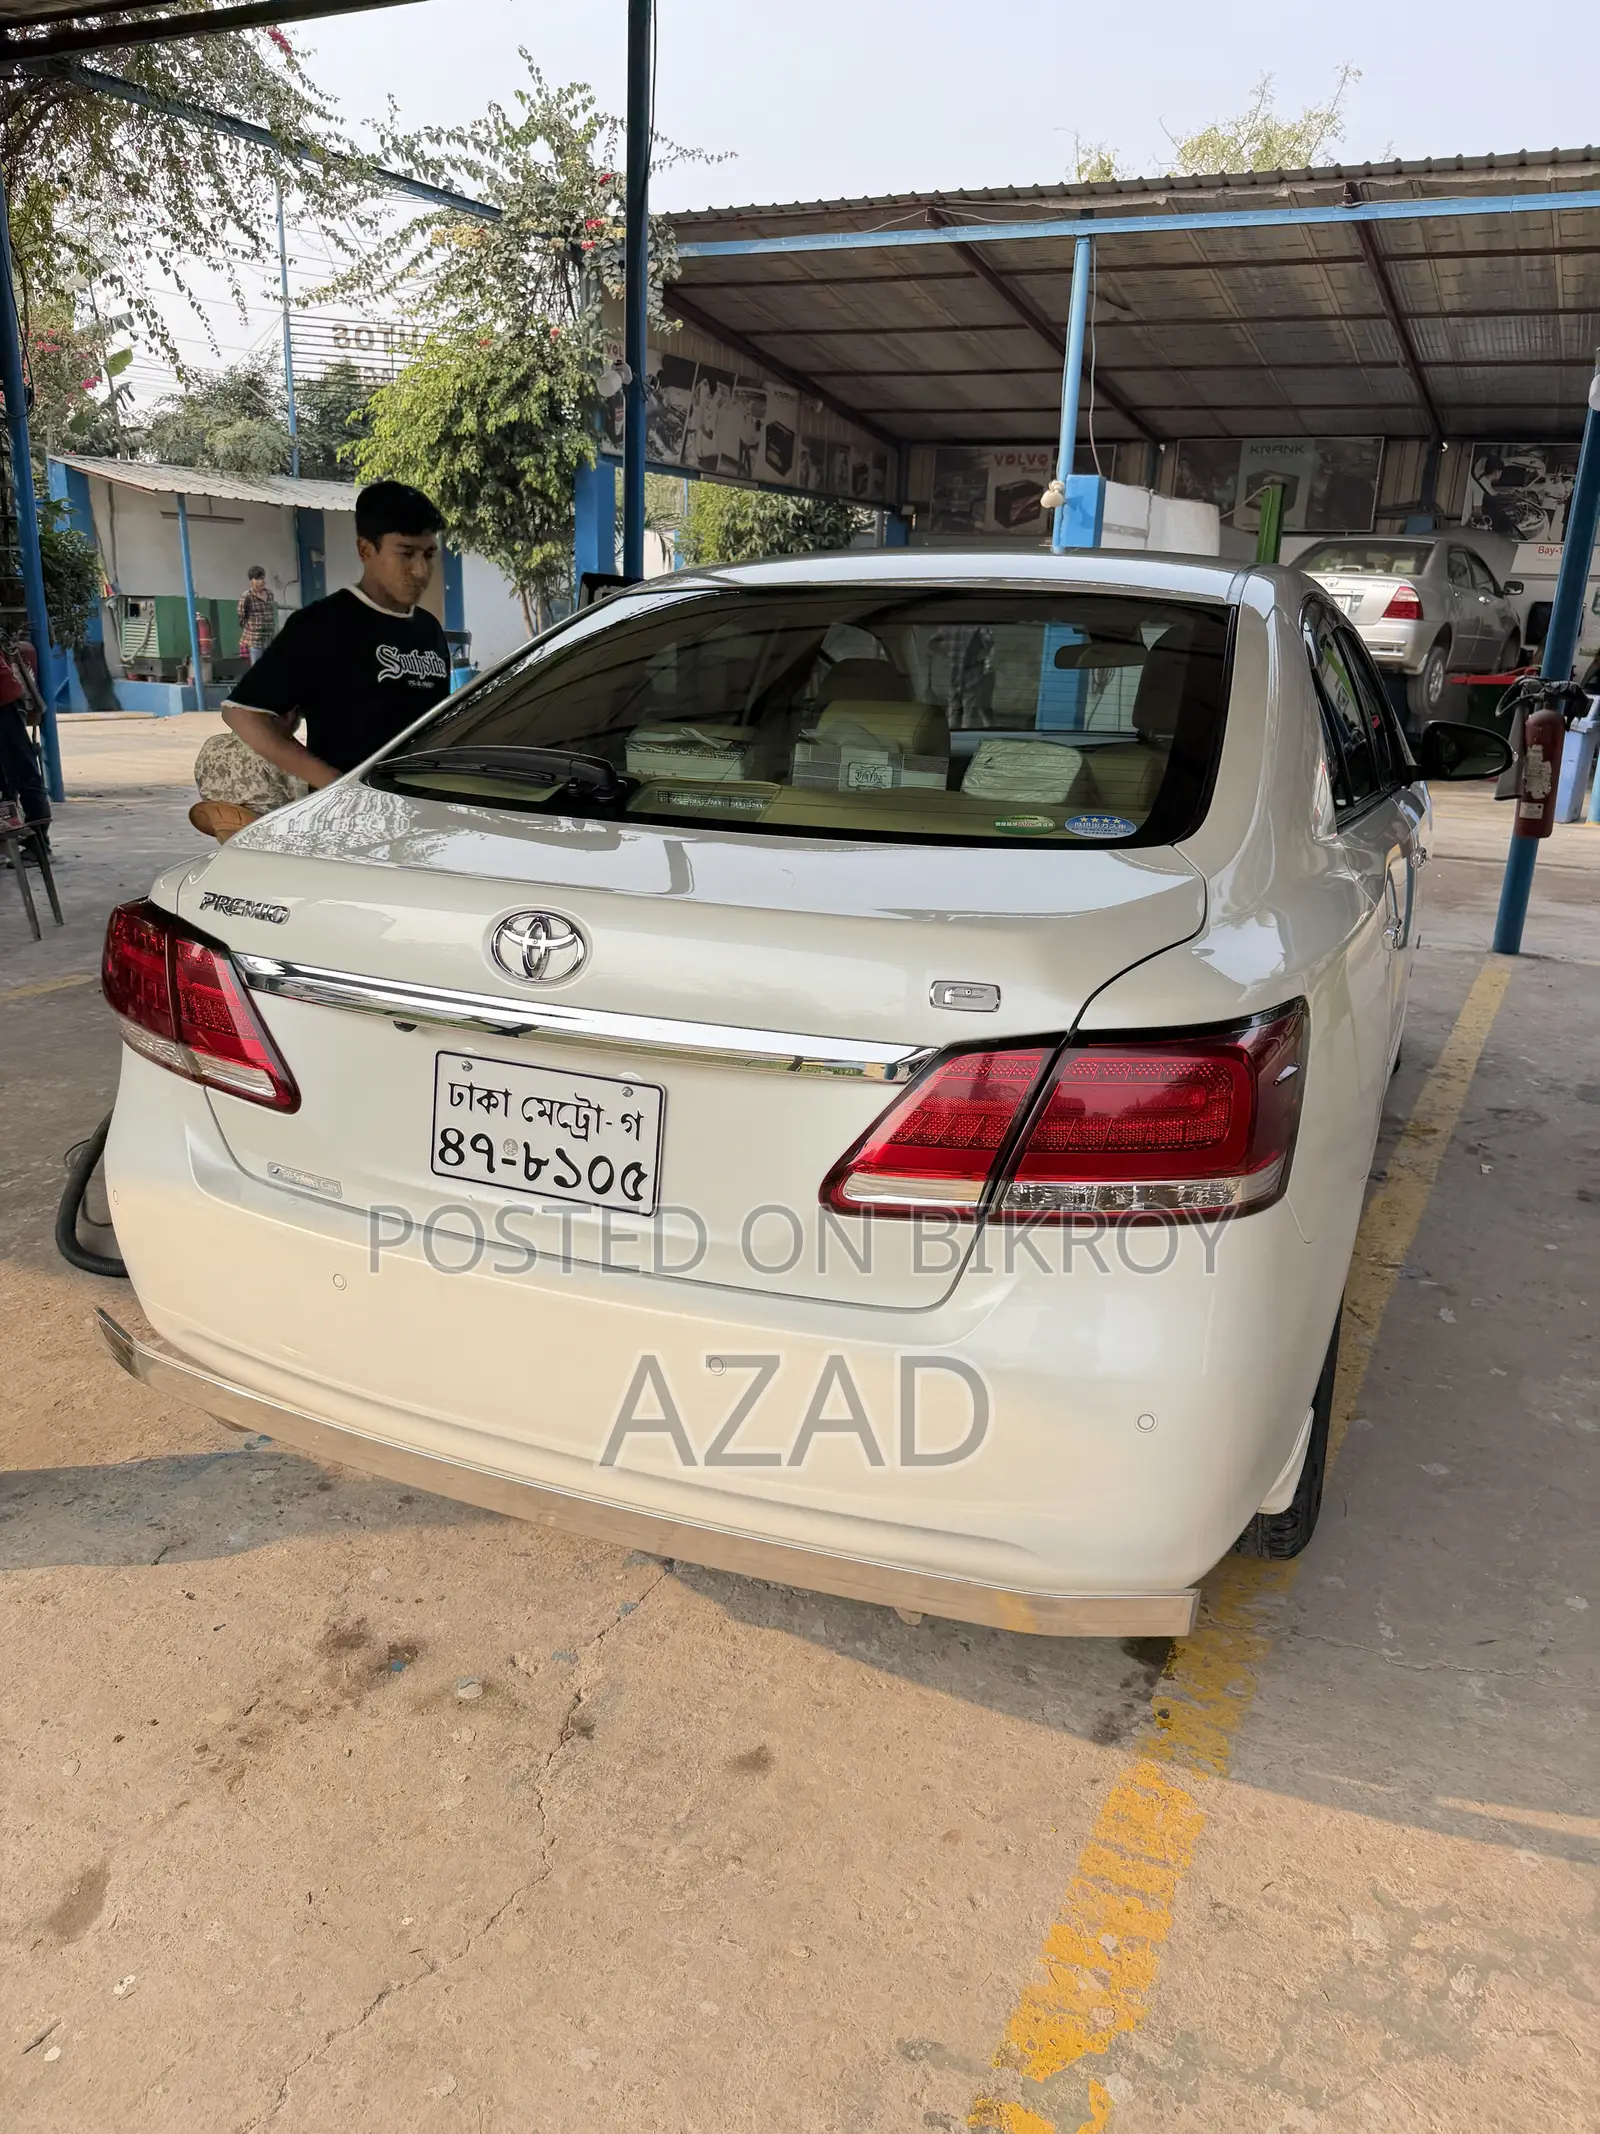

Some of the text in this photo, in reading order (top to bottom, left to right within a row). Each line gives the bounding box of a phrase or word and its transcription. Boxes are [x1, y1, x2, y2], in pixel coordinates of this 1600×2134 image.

[606, 343, 624, 358] VOL
[994, 454, 1049, 466] VOLVO
[1250, 444, 1305, 455] KRANK
[199, 891, 290, 925] PREMIO
[448, 1081, 512, 1118] ঢাকা
[438, 1127, 649, 1202] ৪৭-৮১০৫
